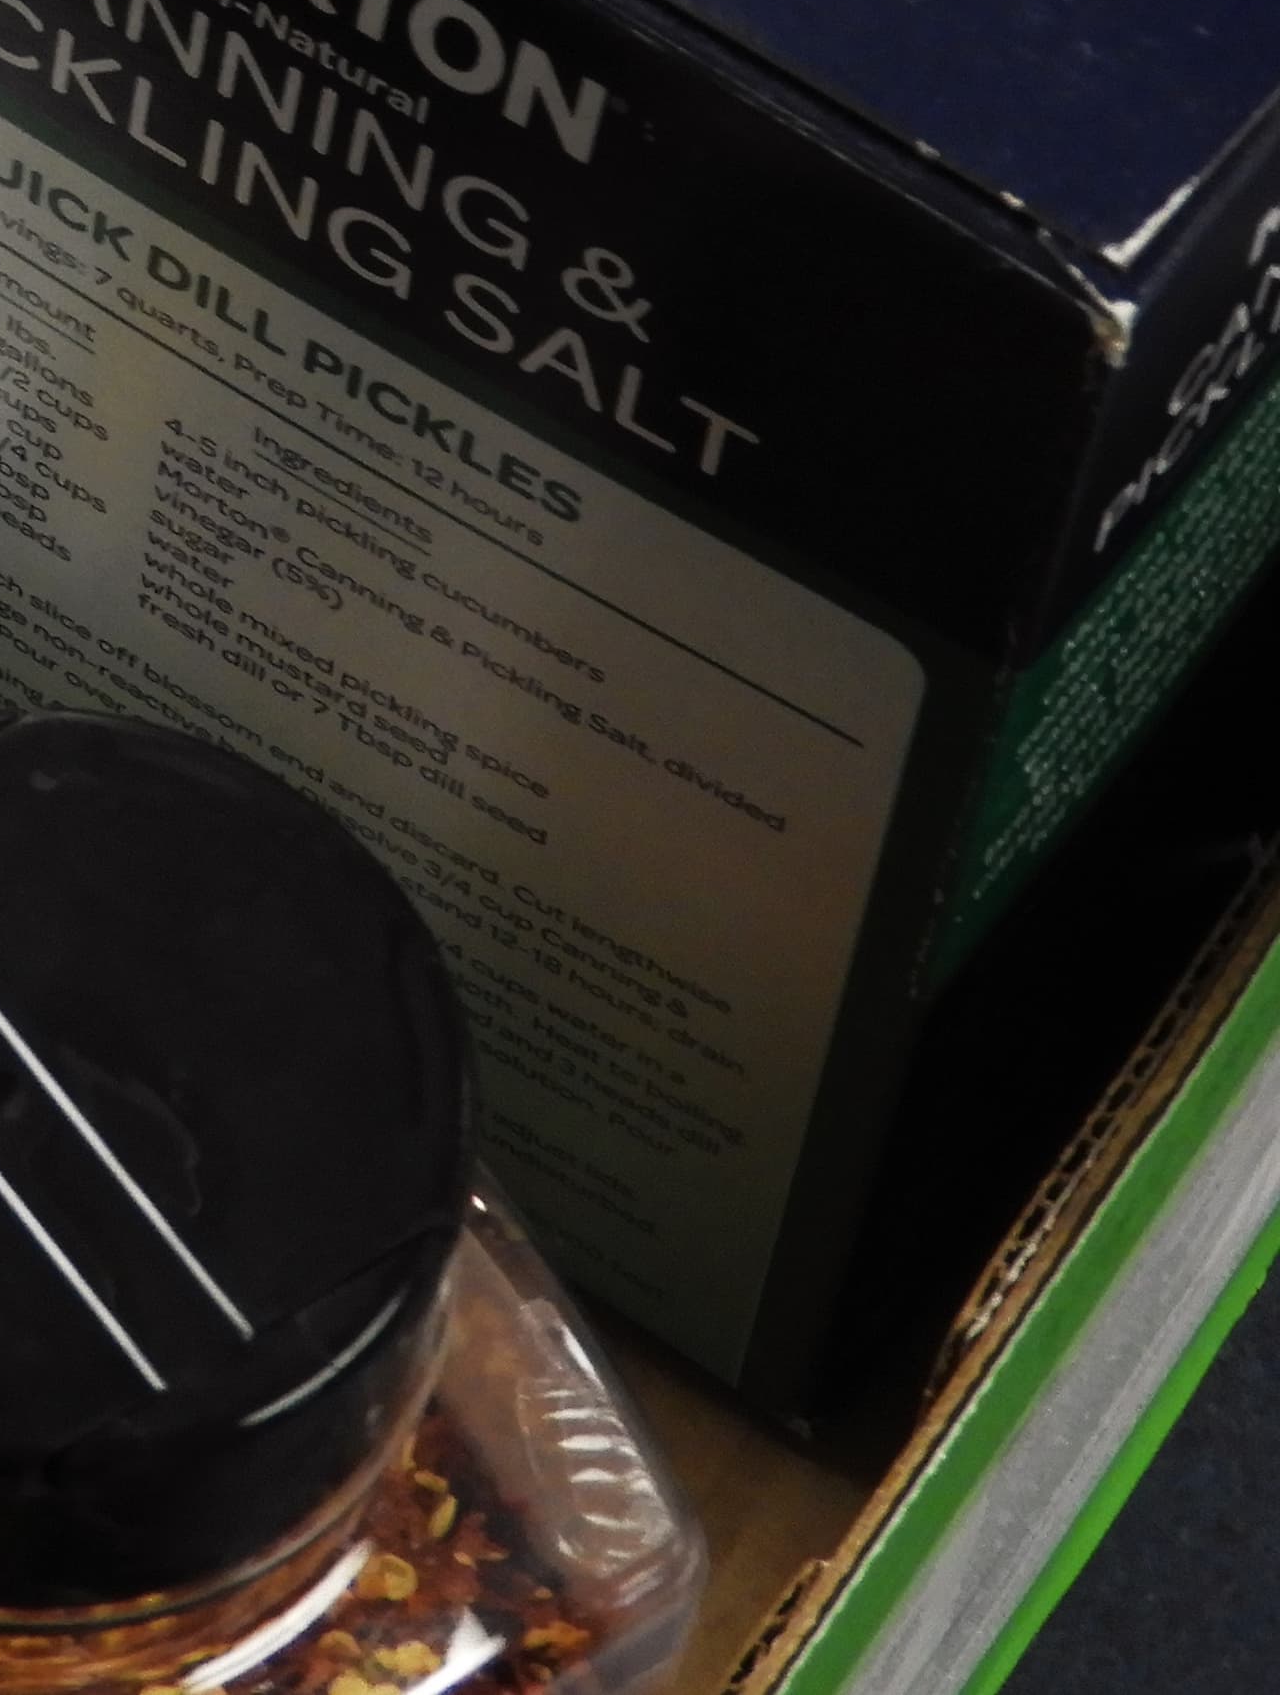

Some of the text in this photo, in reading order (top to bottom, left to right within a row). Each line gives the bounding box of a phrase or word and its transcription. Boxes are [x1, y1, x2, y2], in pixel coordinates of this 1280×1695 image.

[5, 312, 58, 363] lbs.
[557, 224, 664, 348] &
[5, 415, 64, 468] cup
[35, 384, 111, 449] cups
[92, 264, 113, 295] 7
[230, 348, 307, 420] Prep
[311, 394, 405, 473] Time:
[408, 454, 445, 493] 12
[447, 474, 545, 553] hours
[144, 239, 290, 361] DILL
[301, 326, 585, 538] PICKLES
[441, 253, 761, 508] SALT
[33, 456, 108, 520] cups
[147, 503, 235, 575] sugar
[159, 436, 251, 507] water
[252, 421, 433, 554] Ingredients
[146, 523, 235, 594] water
[151, 478, 345, 617] vinegar (5%)
[162, 411, 608, 697] 4-5 inch pickling cucumbers
[135, 588, 548, 852] fresh dill or 7 Tbsp dill seed
[138, 566, 450, 773] whole mustard seed
[142, 544, 551, 808] whole mixed pickling spice
[294, 538, 427, 639] Canning
[429, 620, 454, 650] &
[460, 632, 584, 729] Pickling
[661, 742, 790, 843] divided
